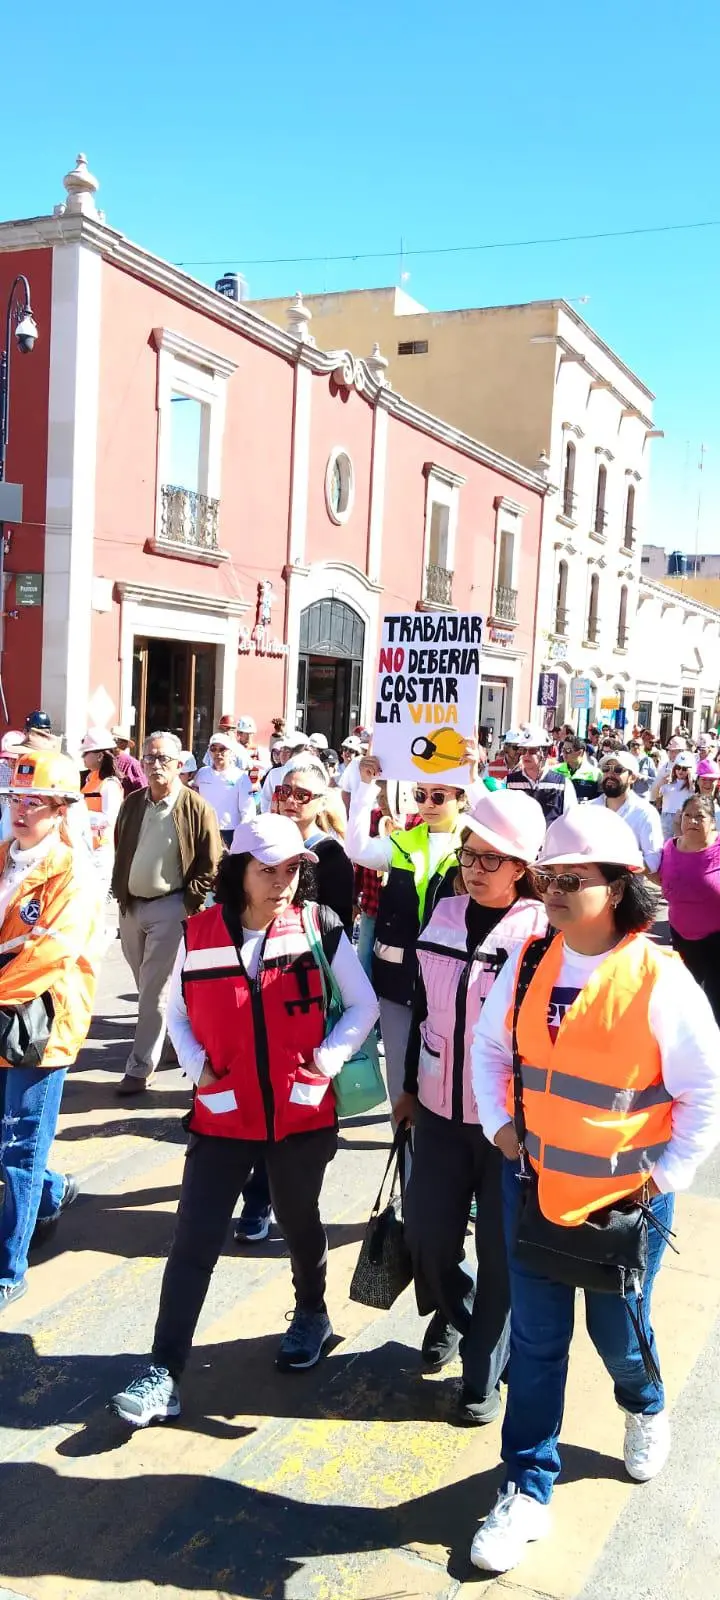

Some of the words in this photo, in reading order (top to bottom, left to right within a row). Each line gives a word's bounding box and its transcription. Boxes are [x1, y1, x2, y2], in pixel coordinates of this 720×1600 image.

[384, 616, 482, 643] TRABAJAR
[379, 647, 405, 673] NO
[408, 648, 480, 675] DEBERIA
[381, 675, 458, 703] COSTAR
[375, 702, 401, 723] LA
[408, 703, 458, 724] VIDA
